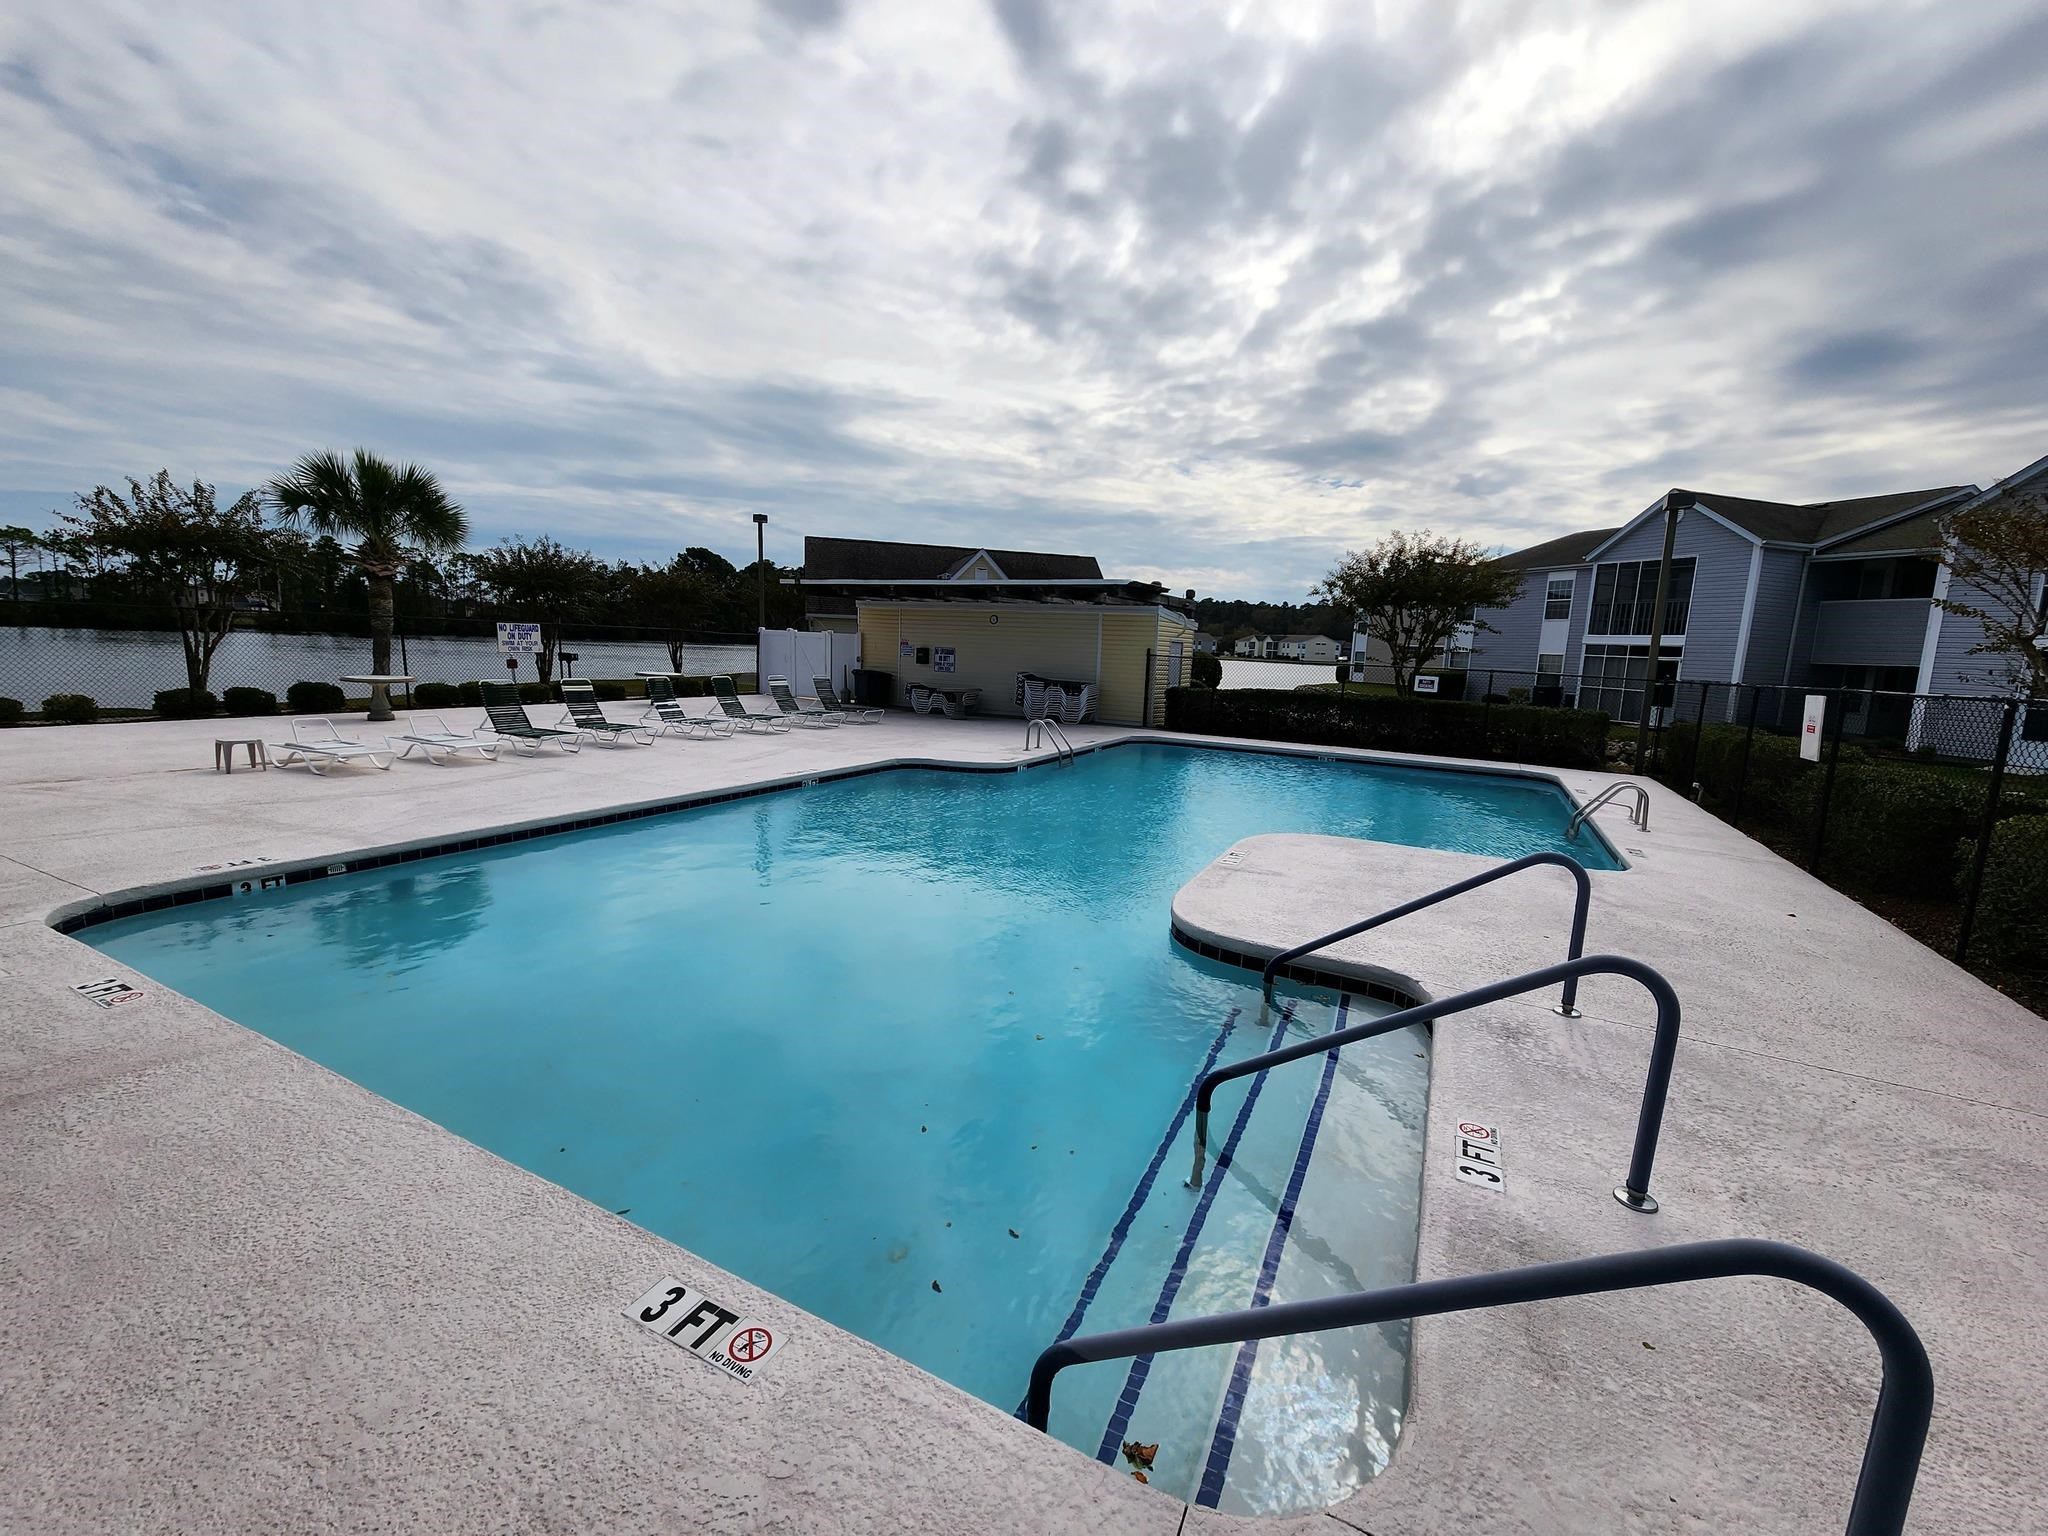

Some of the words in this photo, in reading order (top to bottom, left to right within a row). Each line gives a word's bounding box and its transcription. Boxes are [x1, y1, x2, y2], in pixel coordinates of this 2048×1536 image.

[498, 623, 507, 632] NO
[510, 624, 539, 633] LIFEGUARD
[507, 632, 516, 640] ON
[518, 632, 533, 640] DUTY
[77, 978, 117, 989] 3
[85, 983, 134, 998] FT
[1462, 1139, 1496, 1165] FT
[1459, 1165, 1501, 1183] 3
[640, 1286, 687, 1322] 3
[667, 1299, 740, 1350] FT
[709, 1350, 725, 1362] NO
[722, 1358, 753, 1378] DIVING
